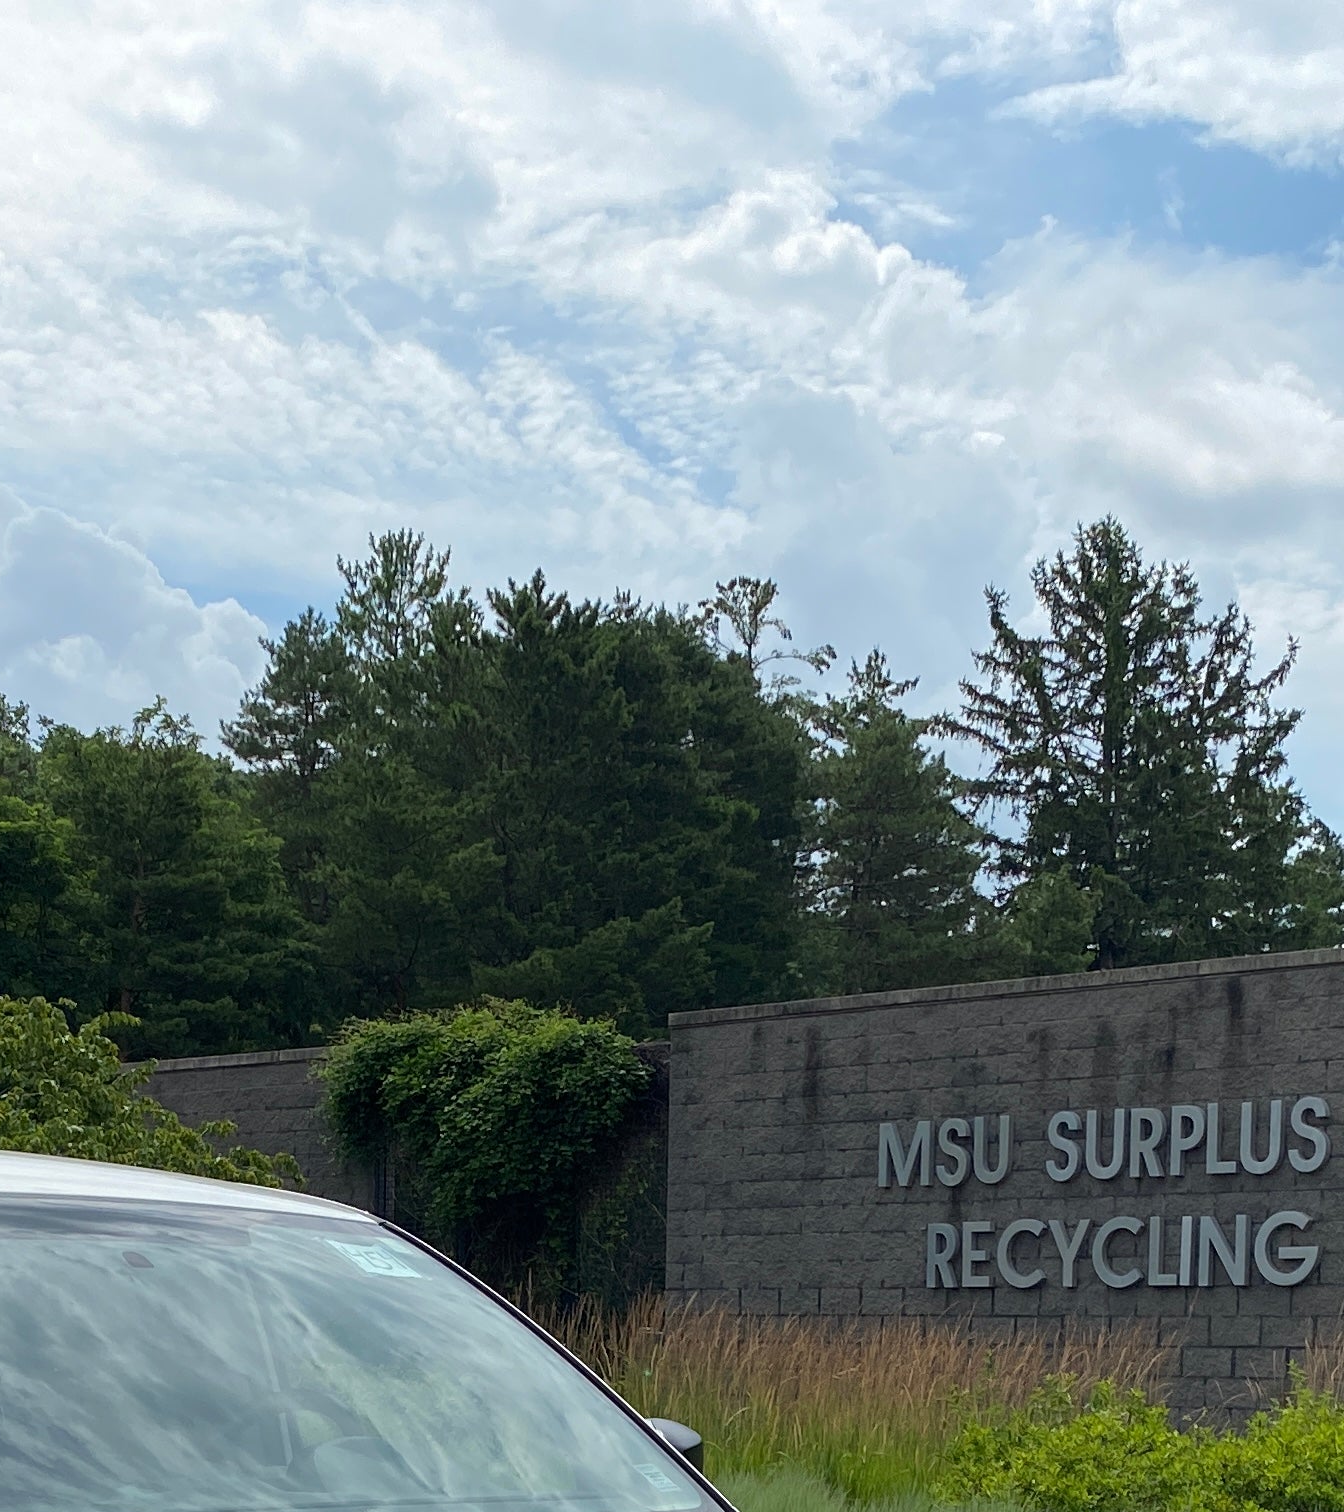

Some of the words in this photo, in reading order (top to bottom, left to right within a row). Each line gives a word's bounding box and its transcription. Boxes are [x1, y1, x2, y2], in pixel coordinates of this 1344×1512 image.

[877, 1117, 1011, 1188] MSU
[1046, 1097, 1330, 1183] SURPLUS
[925, 1210, 1318, 1289] RECYCLING
